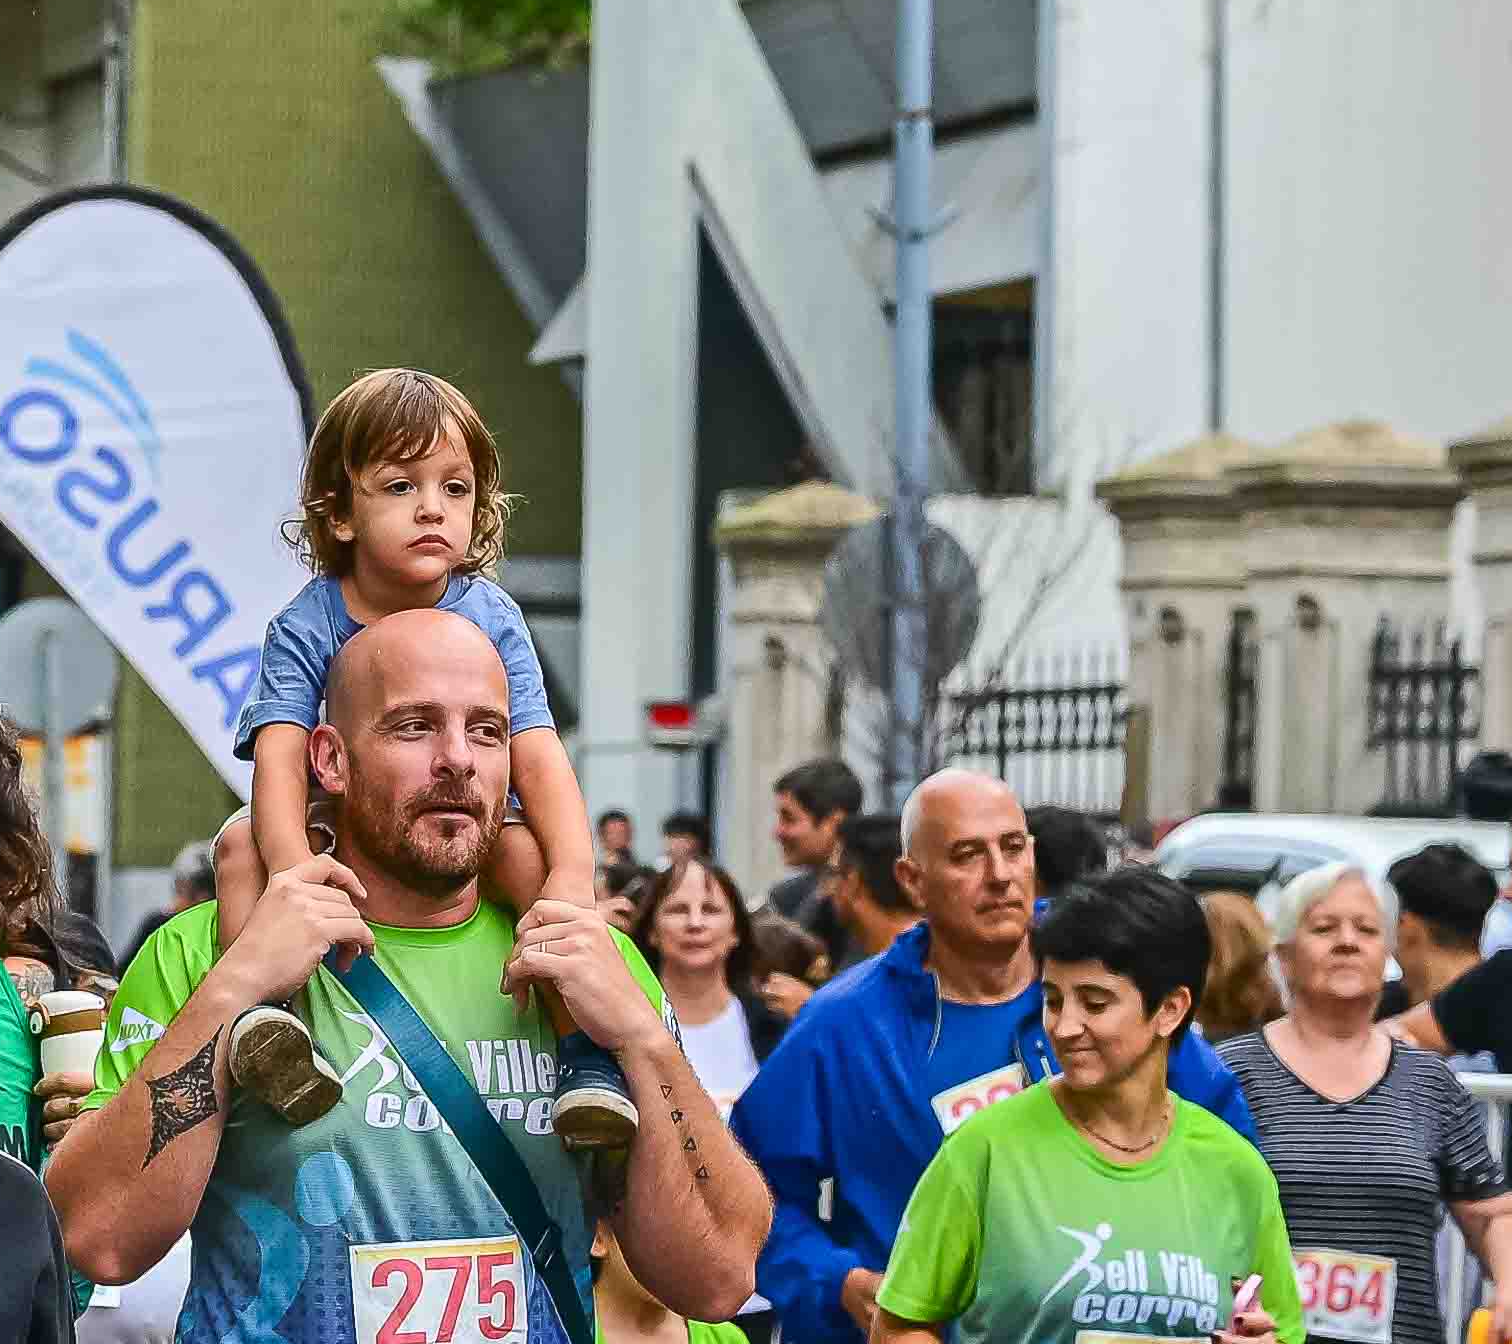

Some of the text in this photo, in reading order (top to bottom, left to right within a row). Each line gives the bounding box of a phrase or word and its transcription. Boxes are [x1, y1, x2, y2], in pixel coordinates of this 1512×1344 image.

[464, 1039, 560, 1094] Ville
[364, 1092, 556, 1136] core
[1158, 1249, 1220, 1307] Ville
